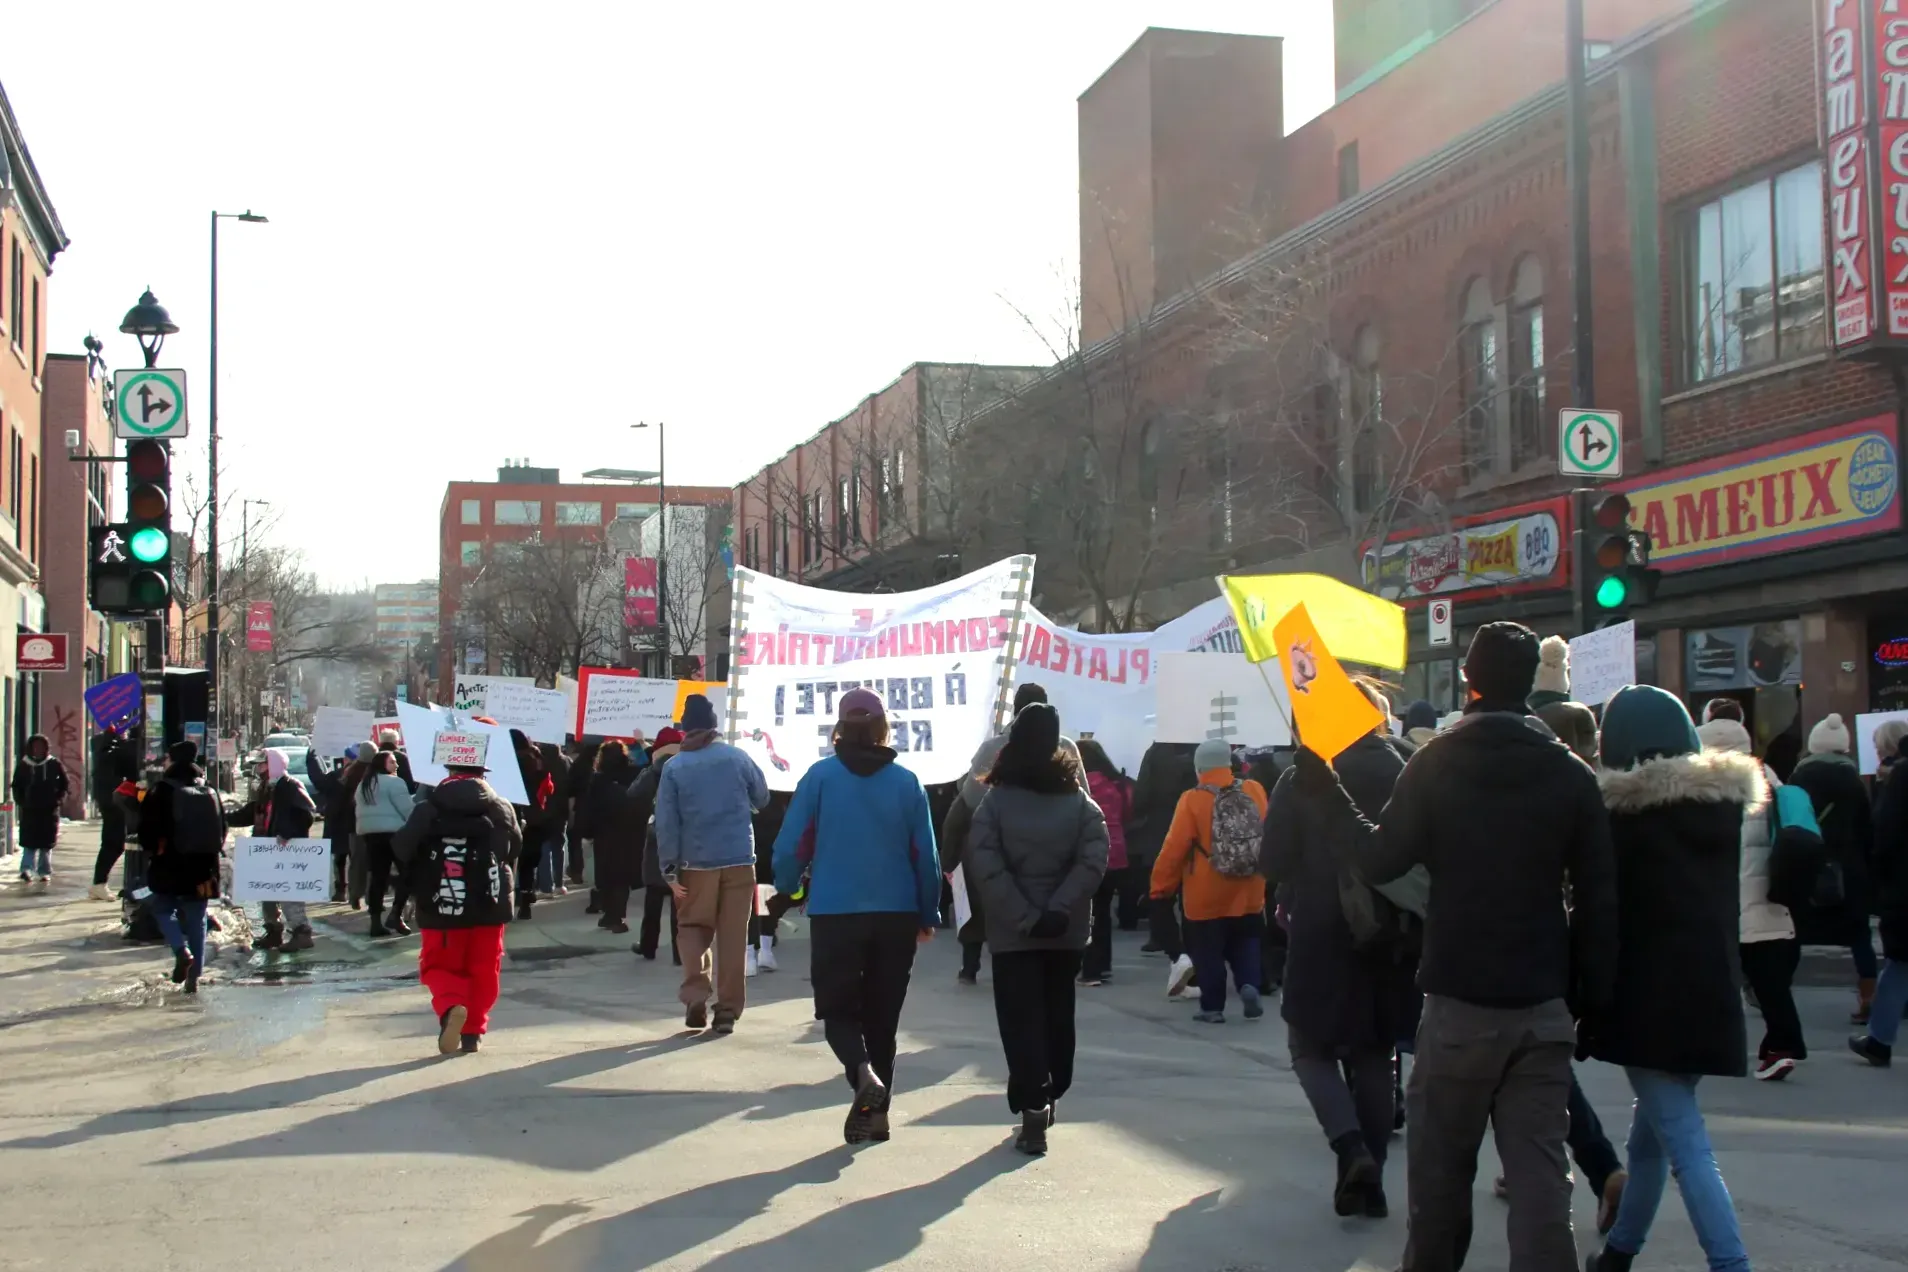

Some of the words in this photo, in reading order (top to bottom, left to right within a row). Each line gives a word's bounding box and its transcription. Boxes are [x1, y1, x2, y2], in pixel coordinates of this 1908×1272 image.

[1627, 457, 1842, 550] AMEUX
[1468, 535, 1514, 570] PIZZA
[1525, 526, 1549, 559] BBQ
